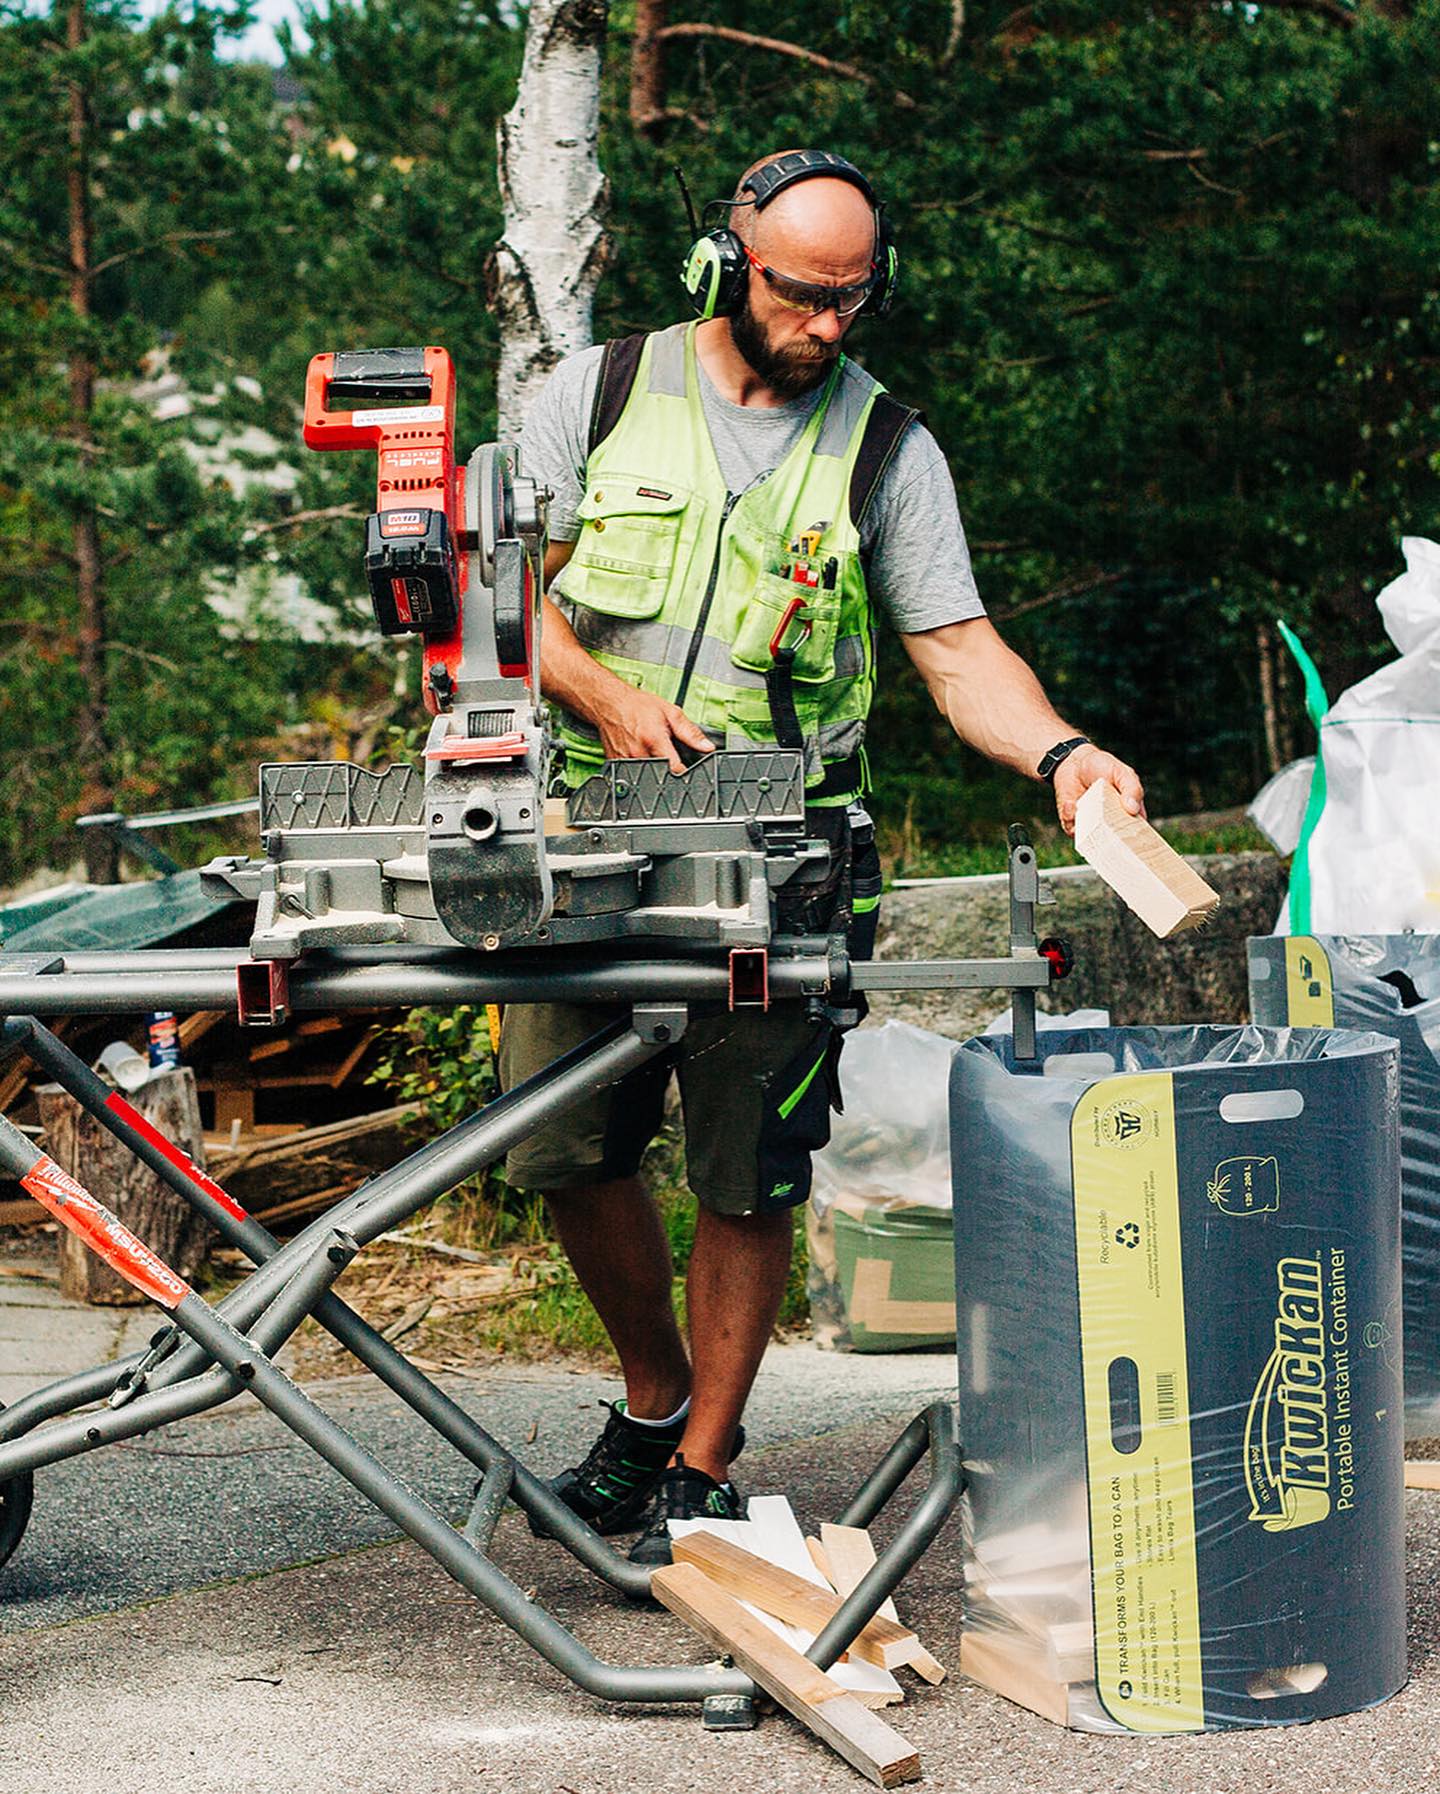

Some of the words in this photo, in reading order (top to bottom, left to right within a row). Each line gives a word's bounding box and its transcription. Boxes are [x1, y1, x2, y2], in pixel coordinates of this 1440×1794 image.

[386, 457, 440, 467] FUEL
[1243, 1171, 1252, 1187] 200
[1244, 1192, 1252, 1207] 120
[1098, 1209, 1111, 1264] Recyclable
[1328, 1247, 1348, 1345] Container
[1332, 1349, 1350, 1420] Instant
[1253, 1465, 1262, 1481] the
[1333, 1424, 1355, 1510] Portable
[1110, 1476, 1121, 1501] CAN
[1112, 1503, 1121, 1511] A
[1112, 1514, 1122, 1529] TO
[1113, 1532, 1124, 1558] BAG
[1114, 1560, 1126, 1593] YOUR
[1116, 1595, 1129, 1674] TRANSFORMS
